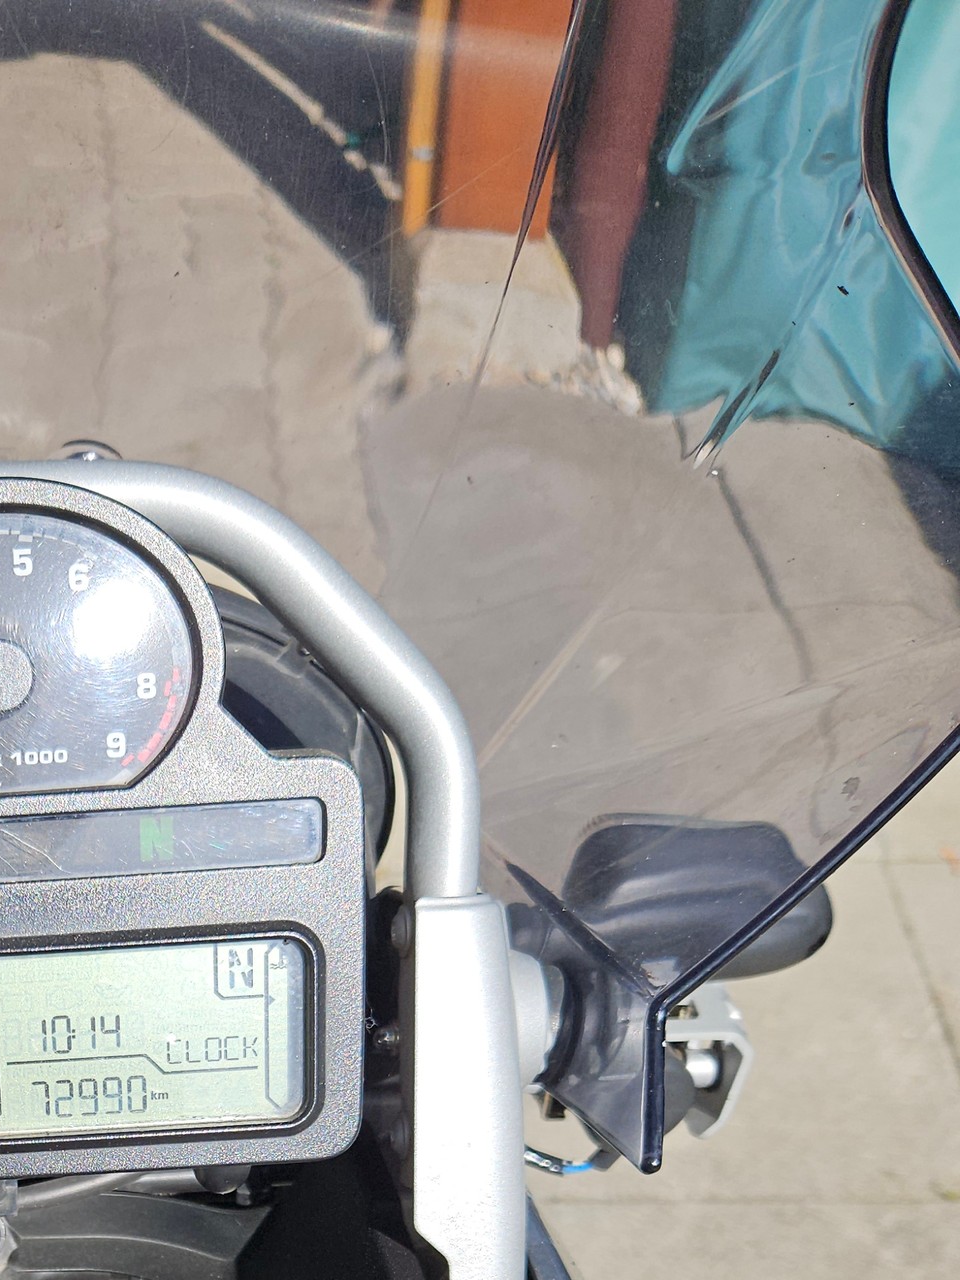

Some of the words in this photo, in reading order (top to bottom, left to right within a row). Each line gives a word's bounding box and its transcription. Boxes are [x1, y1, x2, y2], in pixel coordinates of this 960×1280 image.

[12, 548, 34, 577] 5
[68, 563, 90, 591] 6
[136, 672, 157, 699] 8
[10, 749, 69, 767] 1000
[106, 731, 127, 759] 9
[140, 815, 174, 862] N
[228, 947, 254, 989] N
[41, 1014, 121, 1054] 10:14
[167, 1036, 259, 1065] CLOCK
[31, 1074, 148, 1118] 72990
[150, 1090, 169, 1101] km
